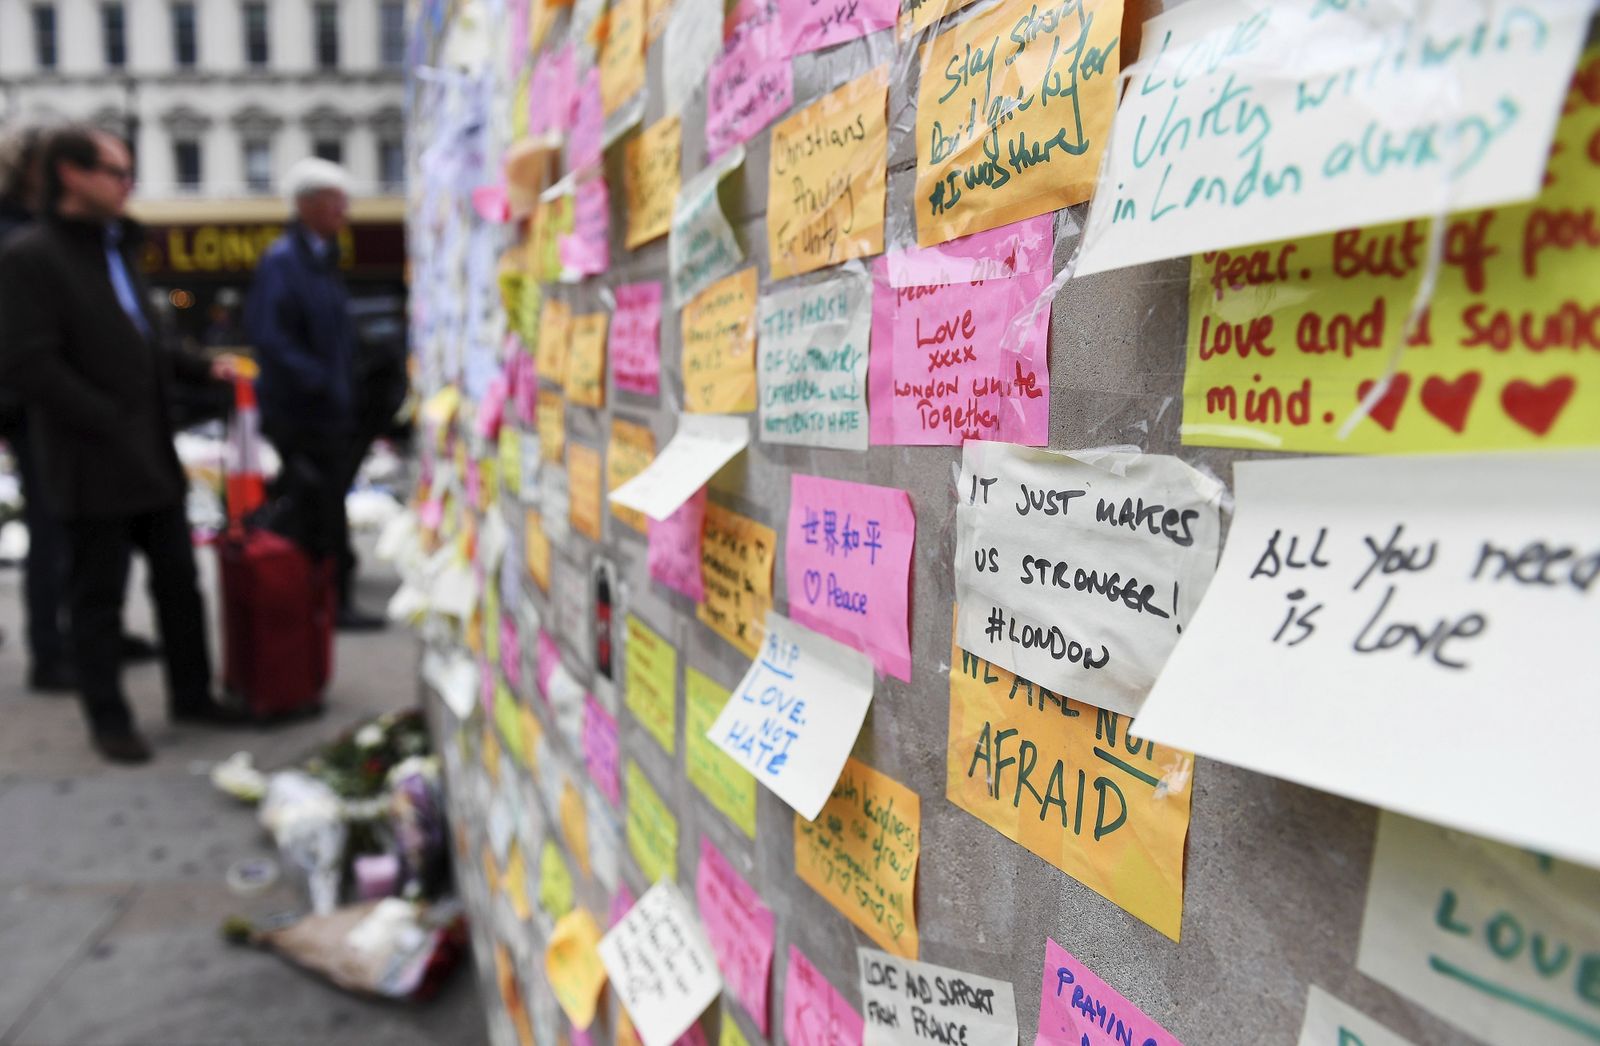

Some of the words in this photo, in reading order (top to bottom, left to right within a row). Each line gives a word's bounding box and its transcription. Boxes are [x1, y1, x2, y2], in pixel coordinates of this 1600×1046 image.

[1132, 74, 1273, 168] Unity
[1112, 183, 1136, 224] in
[1150, 148, 1302, 222] London
[1333, 220, 1424, 281] But
[1443, 211, 1499, 294] of
[916, 309, 977, 349] Love
[1296, 296, 1386, 358] and
[1205, 373, 1336, 426] mind.
[969, 474, 998, 505] IT
[1015, 483, 1087, 516] JUST
[801, 505, 883, 565] 世界和平
[974, 547, 999, 573] US
[827, 572, 868, 616] Peace
[985, 606, 1110, 670] #LONDON
[967, 721, 1128, 841] AFRAID
[911, 1005, 968, 1046] FRANCE
[934, 976, 995, 1016] SUPPORT
[1056, 967, 1158, 1046] PRAYIN
